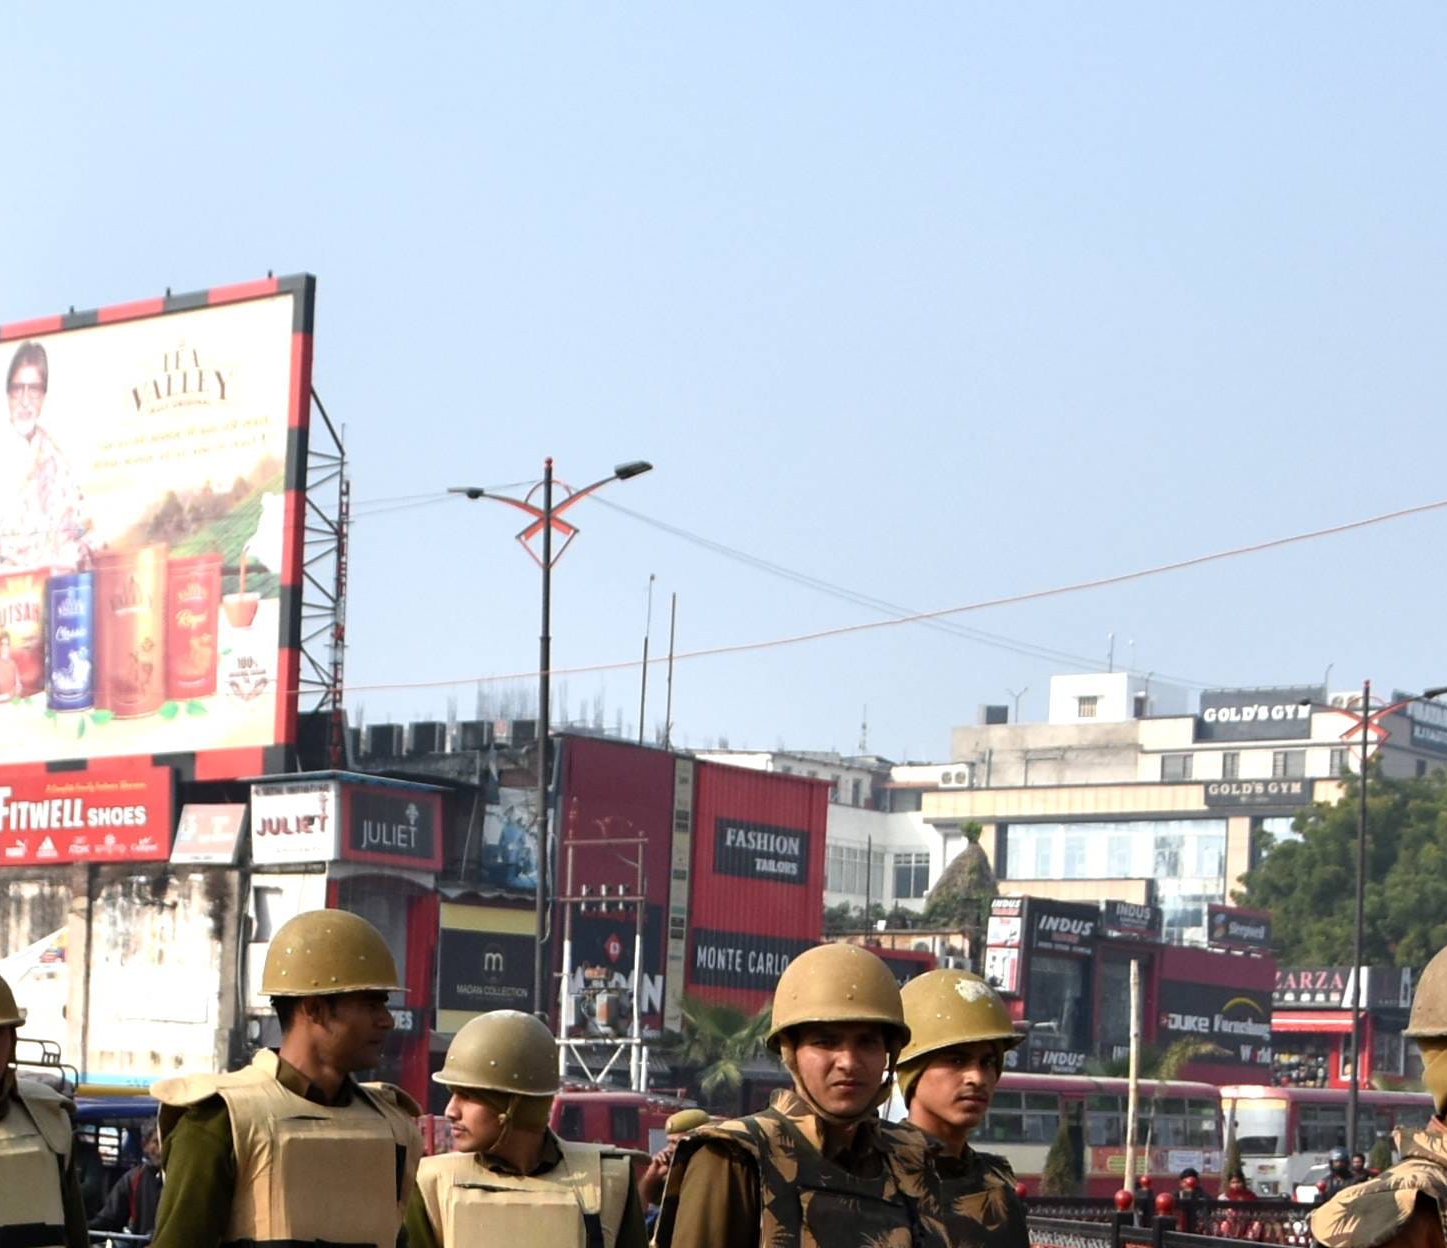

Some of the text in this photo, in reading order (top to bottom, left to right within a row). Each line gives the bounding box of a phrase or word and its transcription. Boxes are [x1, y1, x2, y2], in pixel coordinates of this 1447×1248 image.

[1204, 703, 1311, 723] GOLD'S GYM
[1208, 781, 1302, 796] GOLD'S GYM
[86, 806, 147, 828] SHOES
[256, 814, 329, 836] JULIET
[361, 819, 419, 849] JULIET
[725, 827, 800, 856] FASHION
[755, 858, 799, 875] TAILORS
[992, 898, 1022, 909] INDUS
[1115, 903, 1152, 920] INDUS
[1038, 914, 1095, 937] INDUS
[696, 944, 790, 976] MONTE CARLO
[456, 984, 483, 995] MADAN
[1167, 1013, 1209, 1033] DUKE
[1042, 1050, 1086, 1068] INDUS
